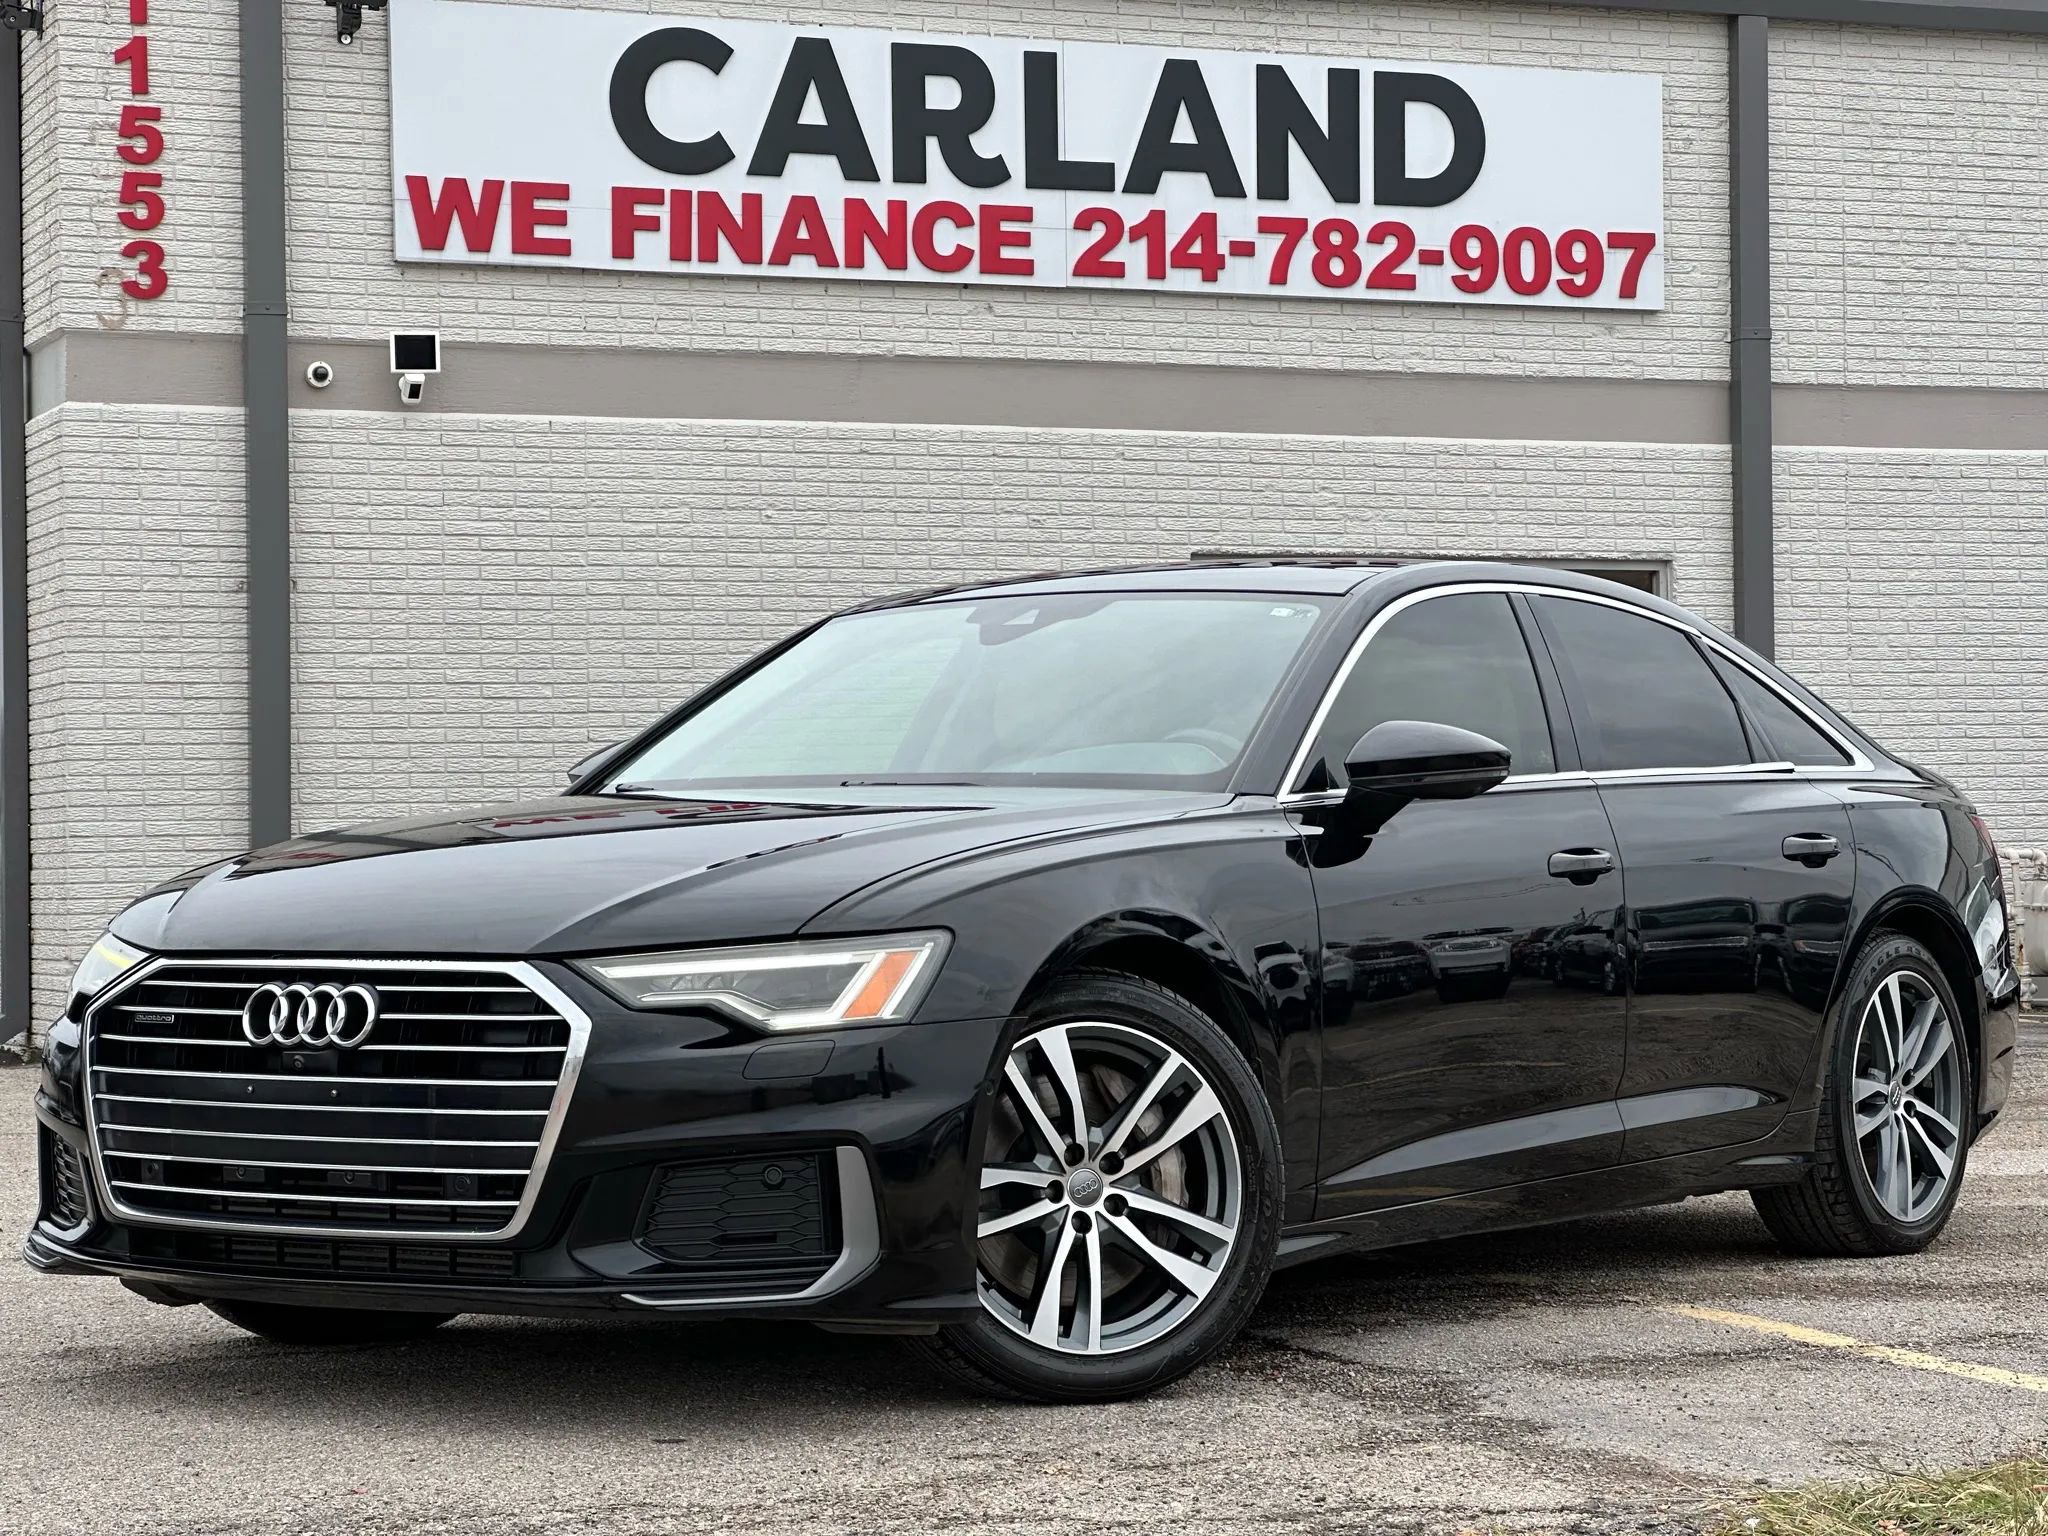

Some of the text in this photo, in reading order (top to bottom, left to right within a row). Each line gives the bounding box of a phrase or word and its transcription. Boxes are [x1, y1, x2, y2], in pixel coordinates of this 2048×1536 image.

[609, 26, 1486, 207] CARLAND
[405, 175, 1656, 298] WE FINANCE 214-782-9097
[1863, 945, 1901, 987] EAGLE
[134, 1014, 172, 1022] quattro
